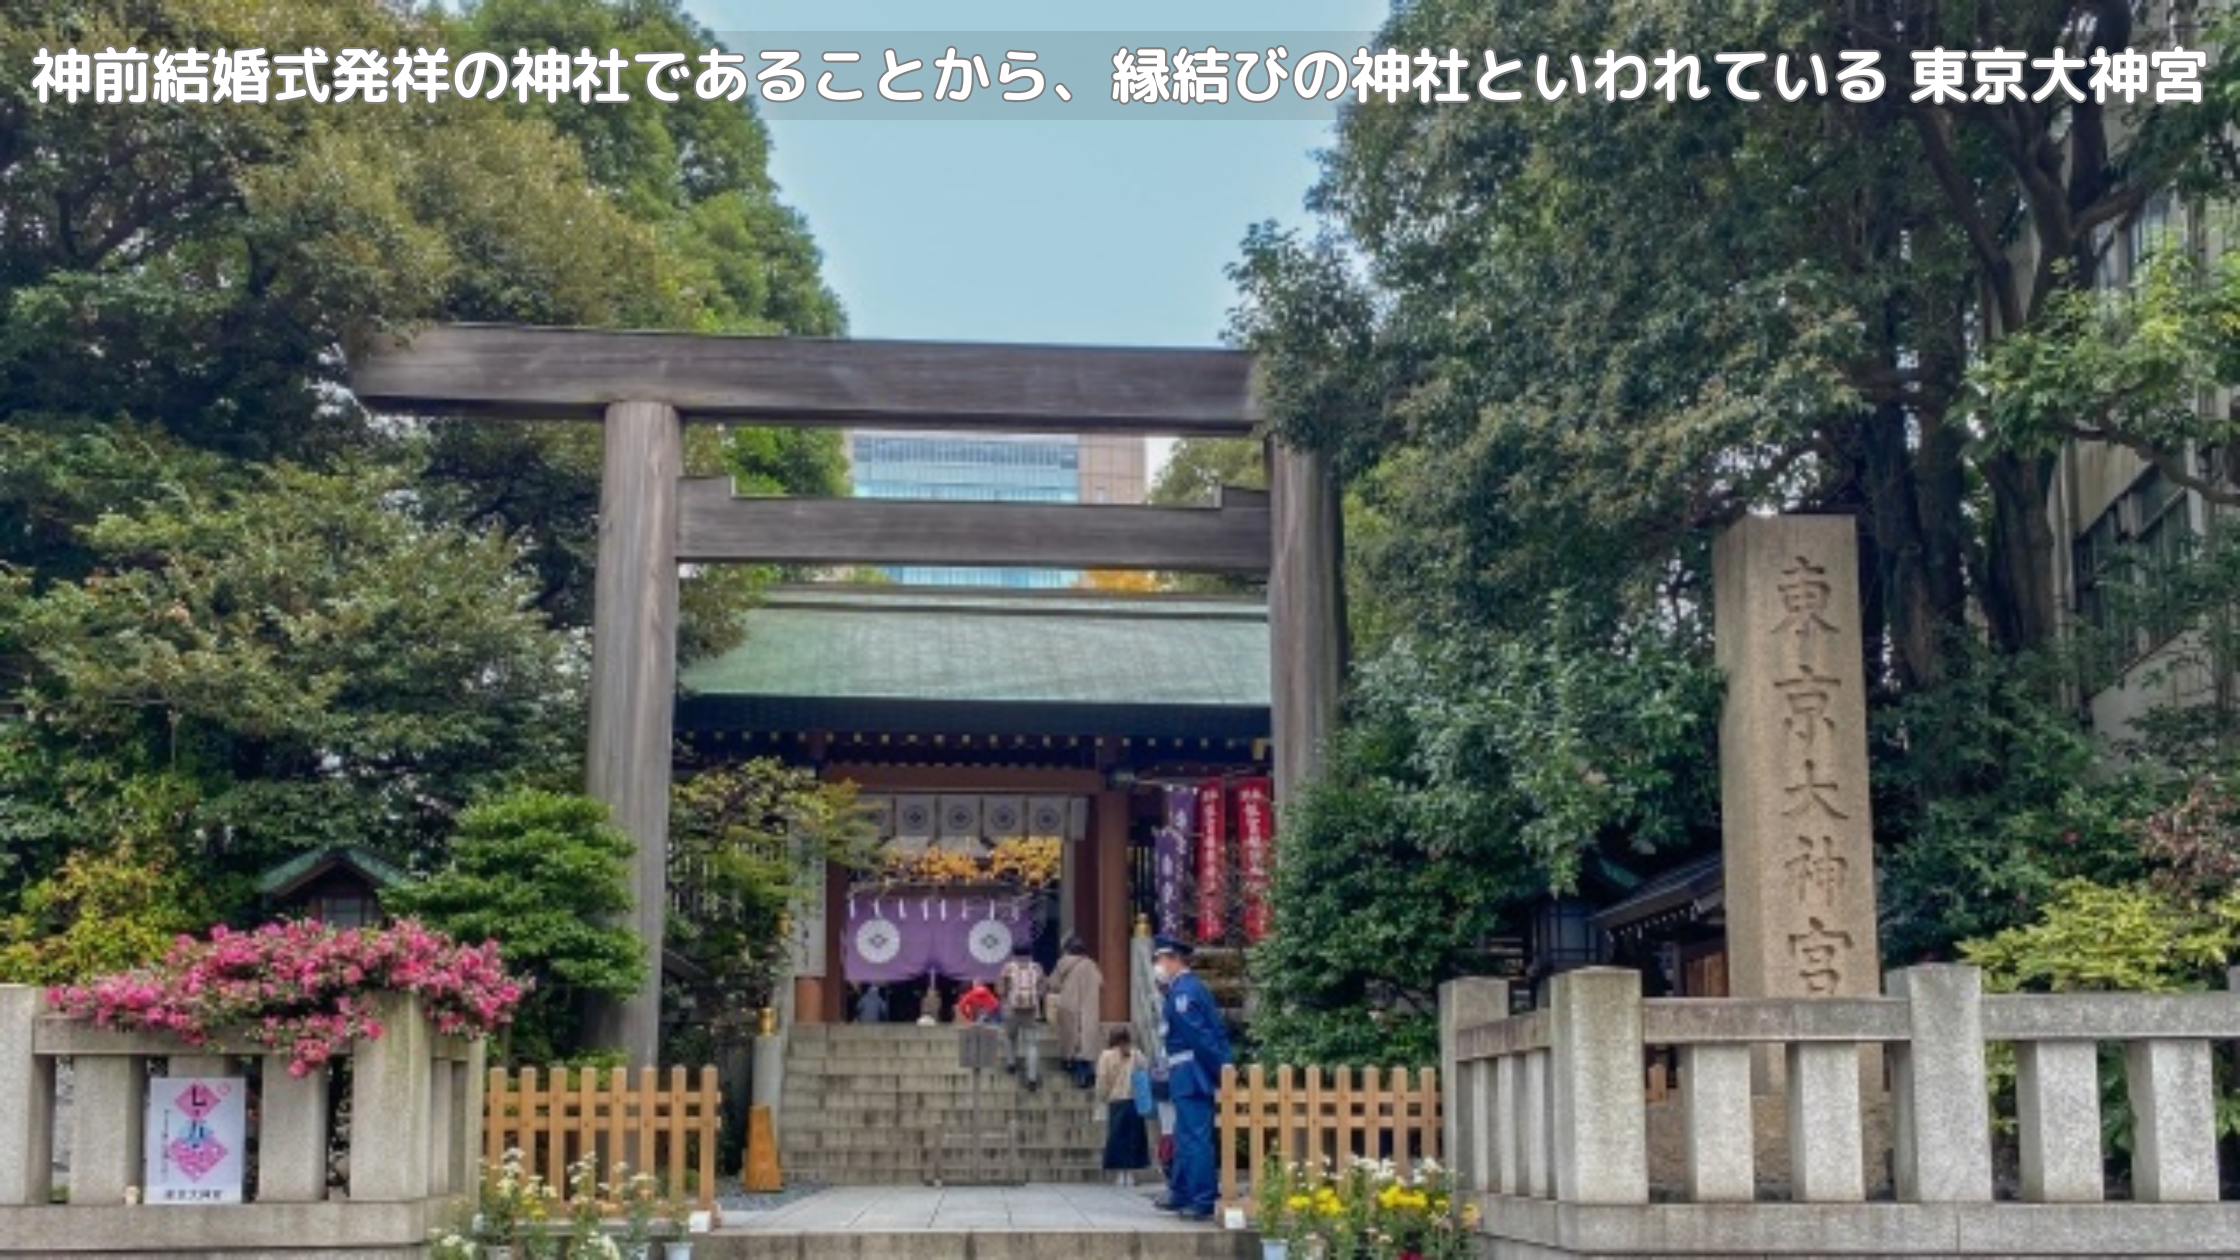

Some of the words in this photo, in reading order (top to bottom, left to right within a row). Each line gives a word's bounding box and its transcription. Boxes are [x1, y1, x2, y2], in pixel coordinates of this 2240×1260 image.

[1770, 556, 1855, 997] 東京大神宮
